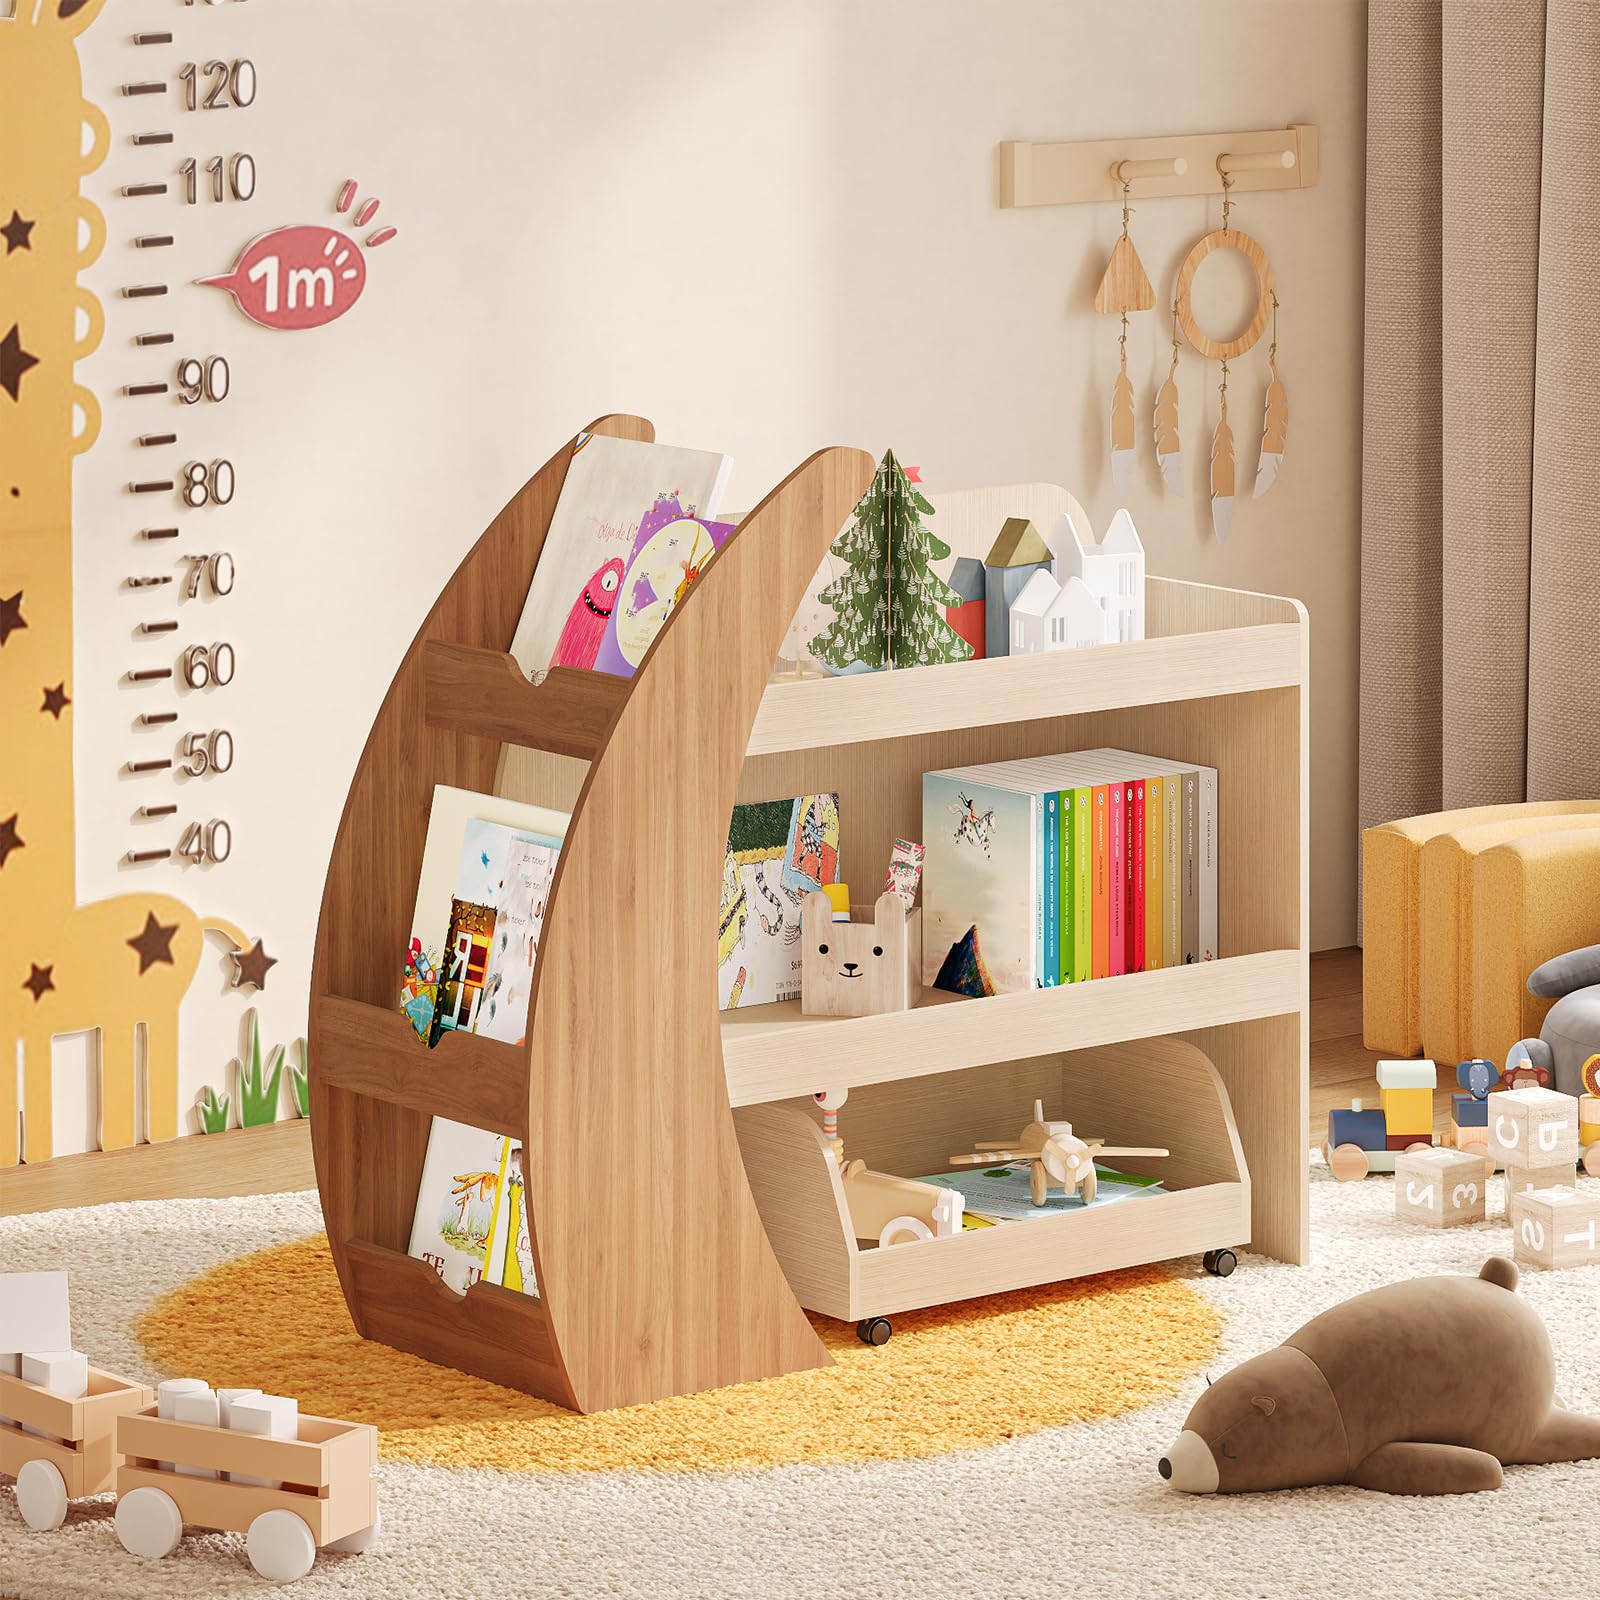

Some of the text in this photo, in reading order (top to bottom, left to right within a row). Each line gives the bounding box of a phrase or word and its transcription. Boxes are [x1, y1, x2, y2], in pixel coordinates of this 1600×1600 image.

[179, 58, 257, 111] 120
[179, 152, 256, 204] 110
[248, 256, 335, 312] 1m
[178, 355, 230, 404] 90
[184, 458, 235, 508] 80
[184, 552, 235, 598] 70
[184, 641, 235, 689] 60
[184, 729, 233, 777] 50
[180, 818, 231, 864] 40
